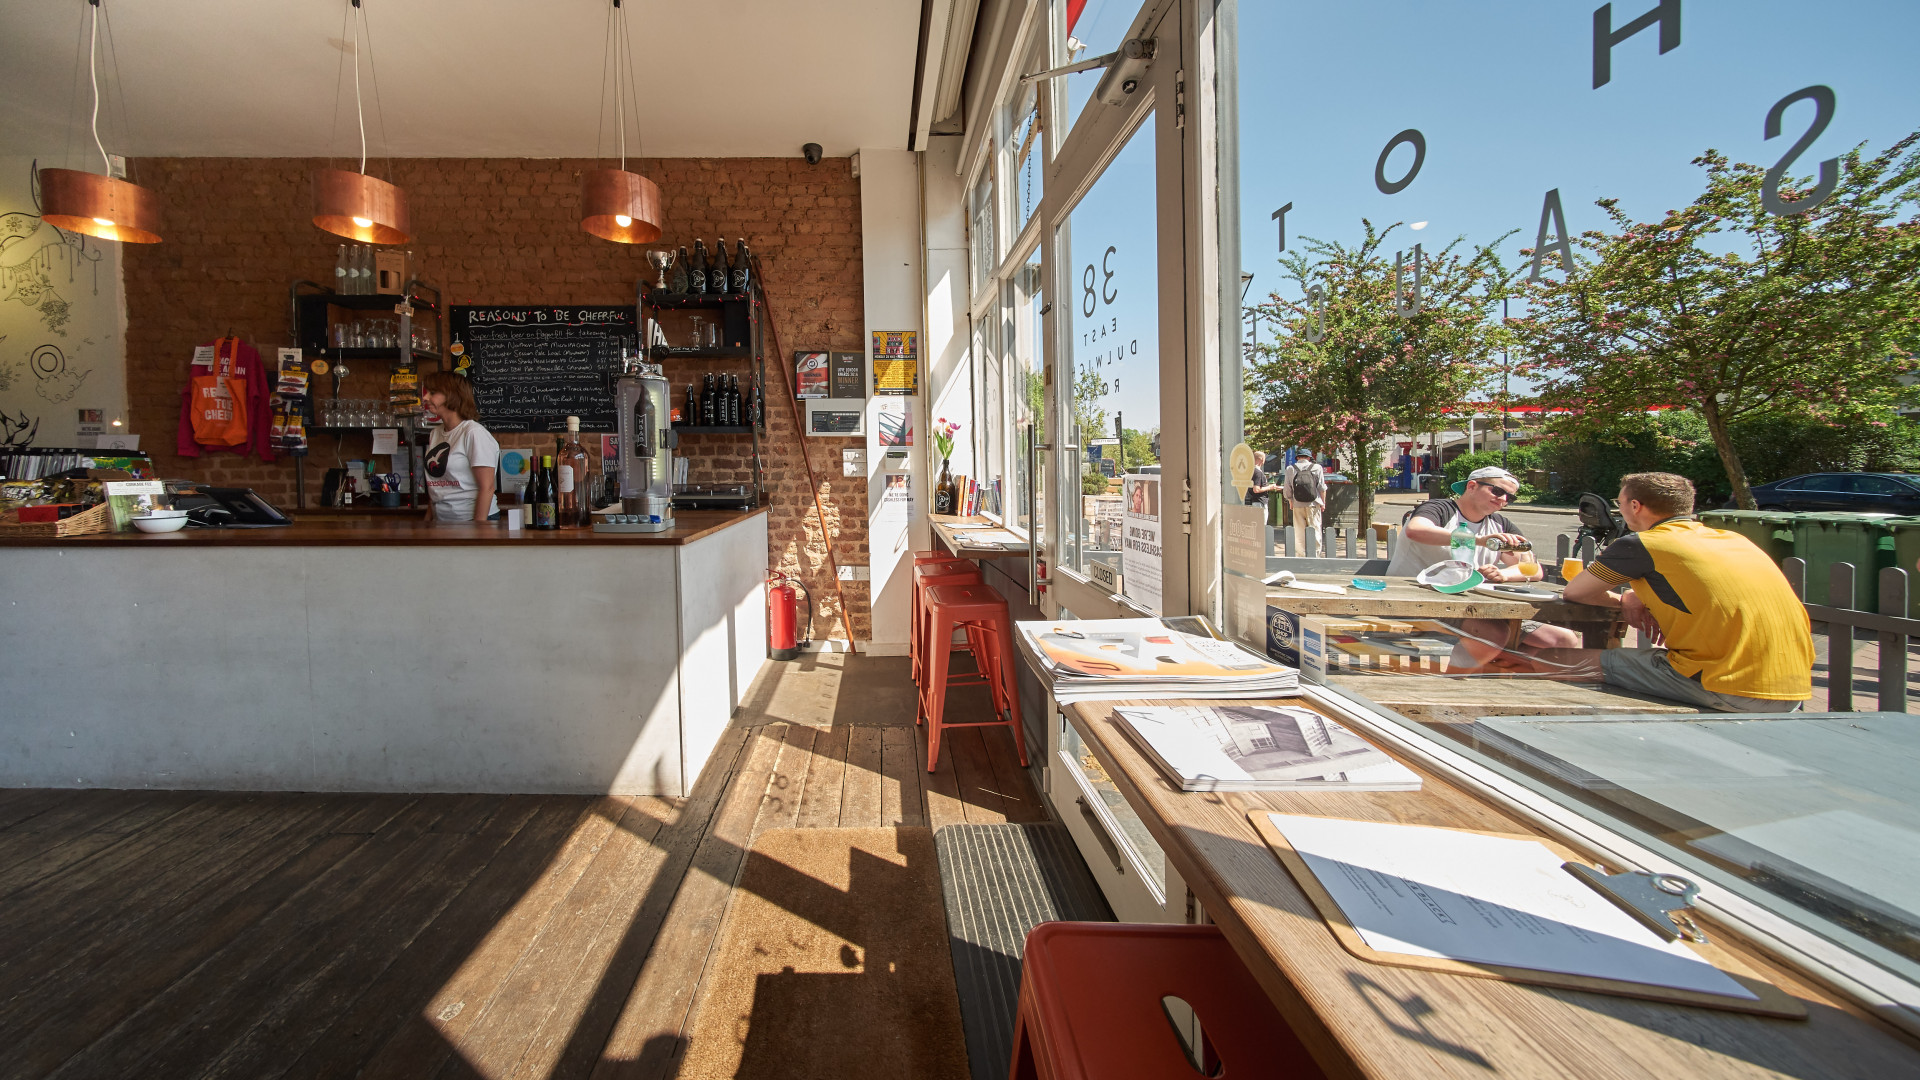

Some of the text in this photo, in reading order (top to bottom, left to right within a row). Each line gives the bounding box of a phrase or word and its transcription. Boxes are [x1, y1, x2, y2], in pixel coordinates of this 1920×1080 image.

[469, 310, 528, 323] REASONS
[534, 311, 547, 322] TO
[556, 309, 570, 321] BE
[1094, 566, 1112, 585] CLOSED
